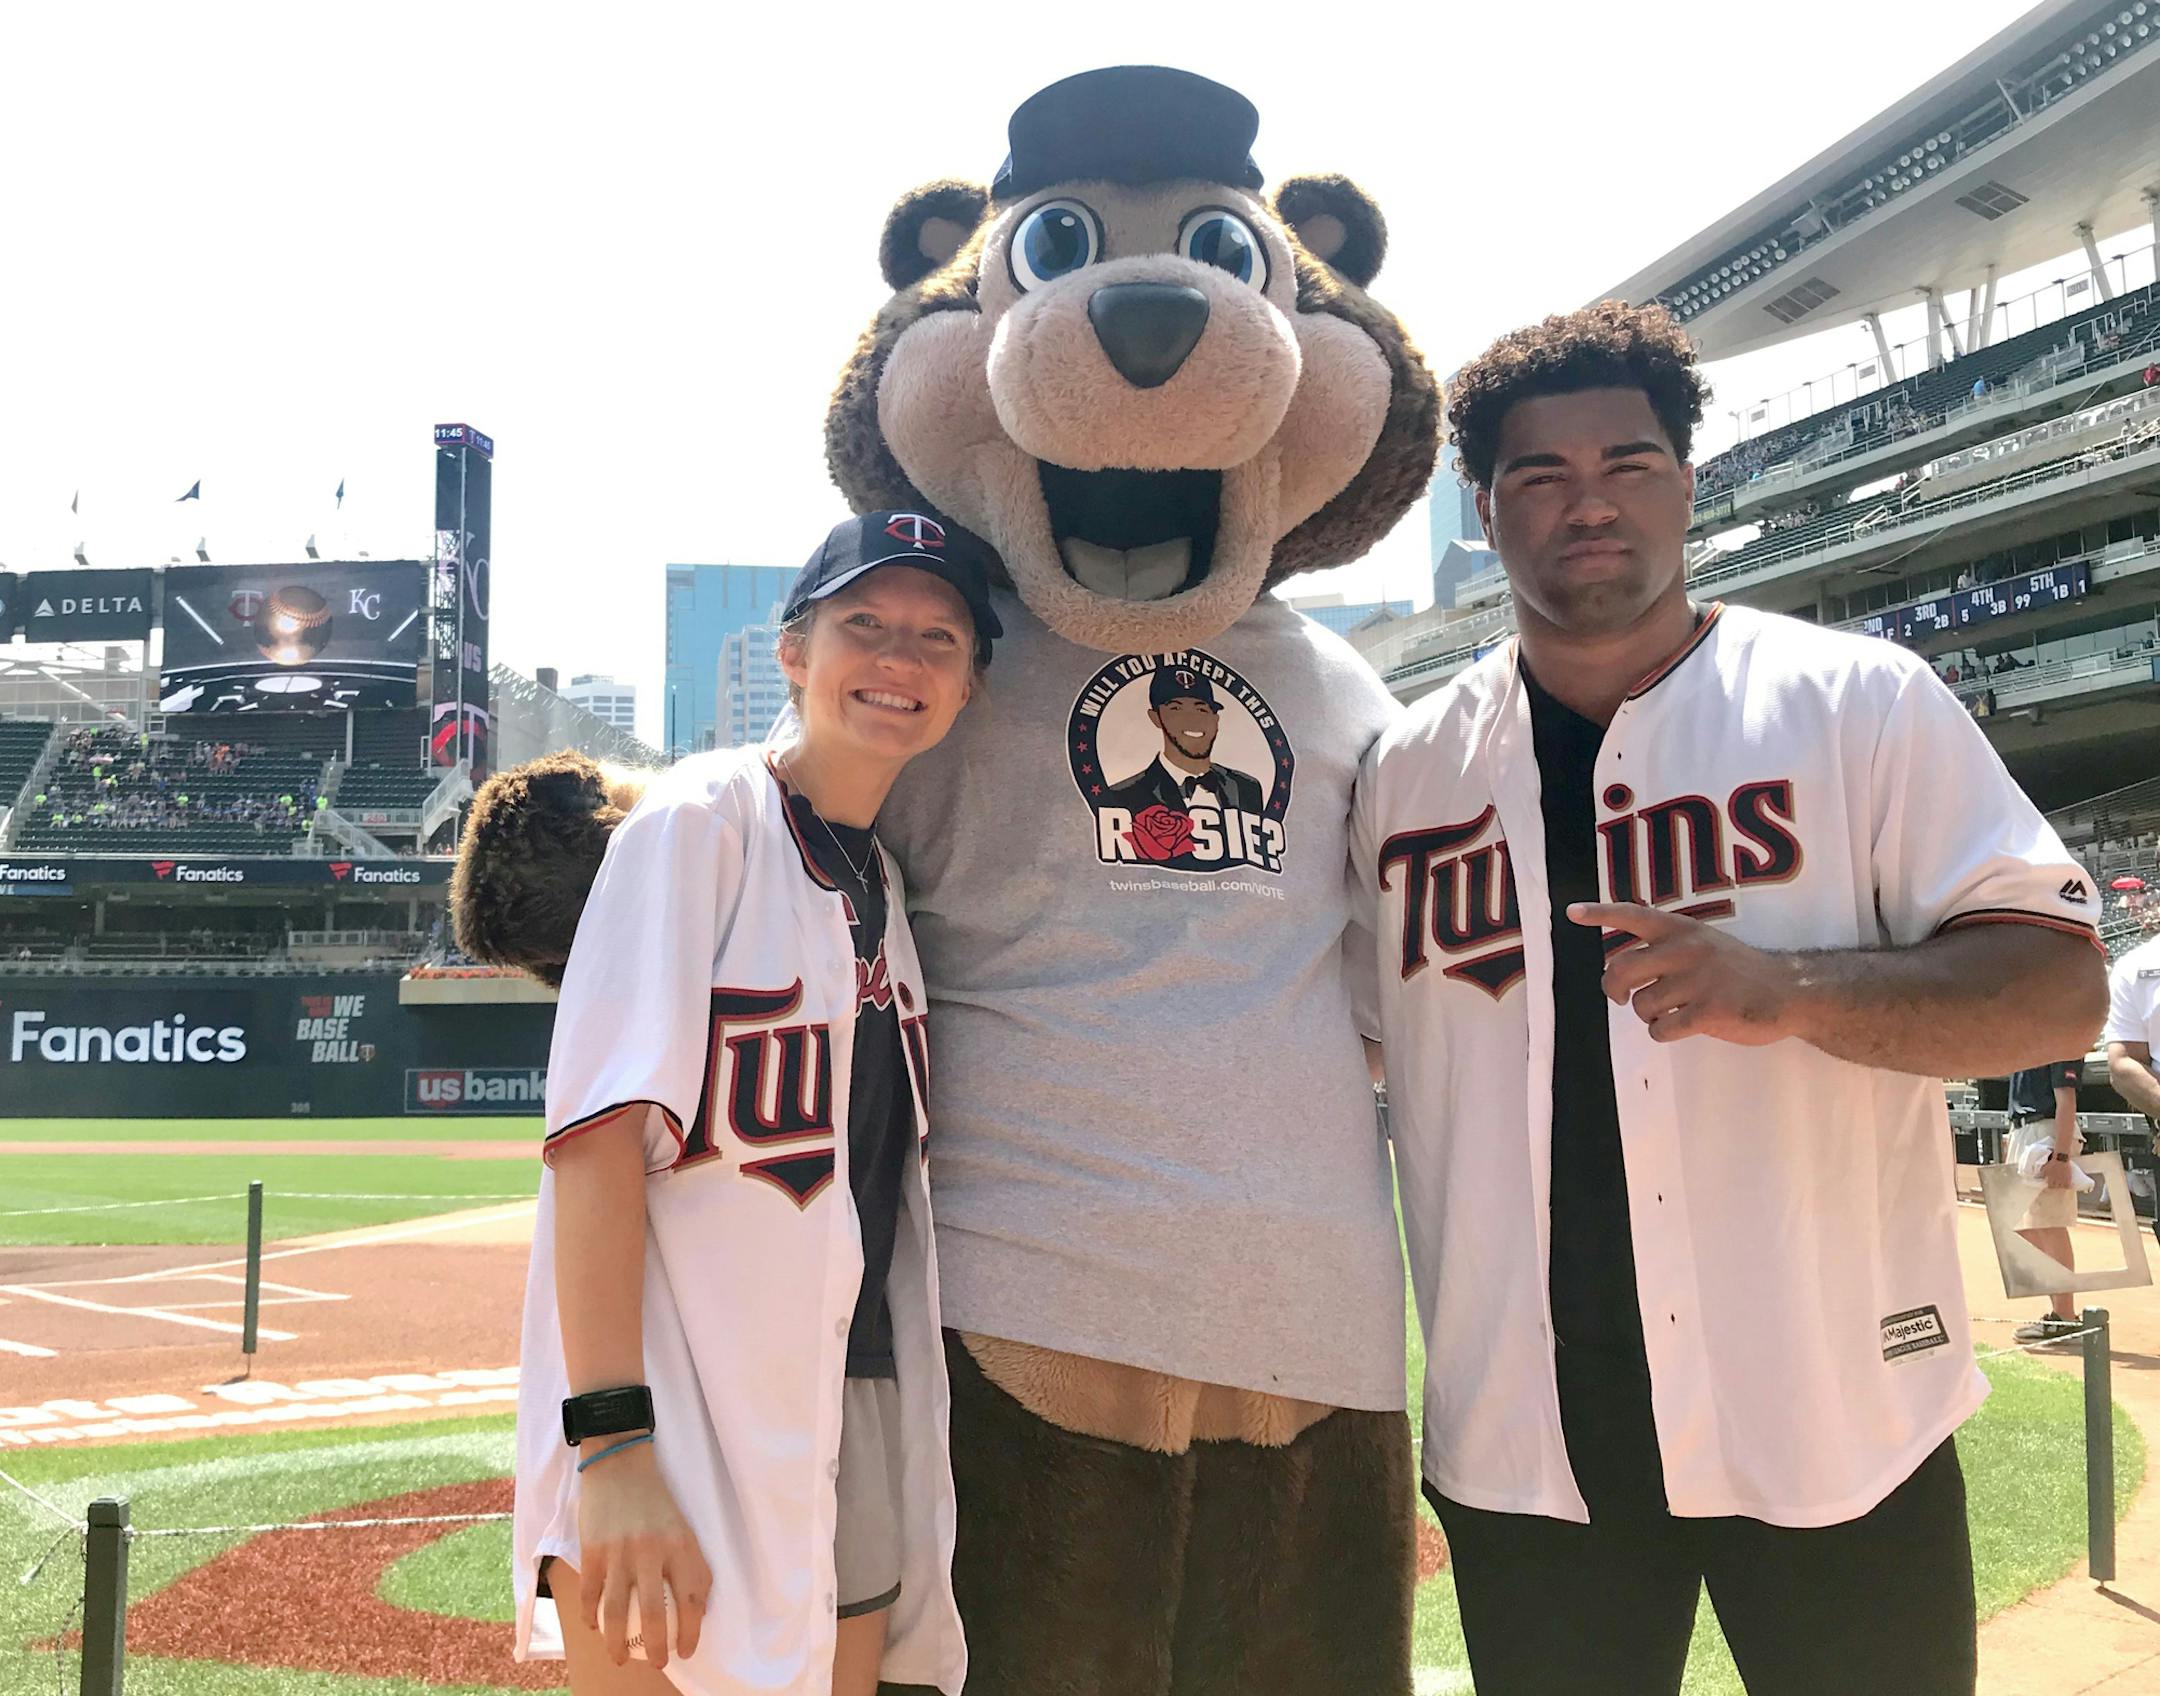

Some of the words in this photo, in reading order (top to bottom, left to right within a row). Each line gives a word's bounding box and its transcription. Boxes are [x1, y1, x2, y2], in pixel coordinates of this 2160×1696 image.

[435, 428, 463, 438] 11:45
[2030, 572, 2055, 592] 5TH
[1971, 586, 1994, 607] 4TH
[2052, 584, 2069, 600] 1B
[61, 597, 143, 615] DELTA
[348, 588, 381, 620] KC
[1990, 600, 2007, 616] 3B
[2015, 594, 2031, 610] 99
[1915, 602, 1938, 622] 3RD
[1961, 609, 1970, 622] 5
[1904, 624, 1913, 637] 2
[1934, 614, 1949, 630] 2B
[1079, 676, 1120, 717] WILL
[1115, 654, 1157, 680] YOU
[1237, 685, 1275, 729] THIS
[0, 864, 66, 881] Fanatics
[176, 865, 244, 882] Fanatics
[354, 866, 421, 883] Fanatics
[333, 995, 365, 1017] WE
[11, 1010, 247, 1063] Fanatics
[296, 1018, 349, 1040] BASE
[312, 1040, 359, 1062] BALL
[1887, 1317, 1934, 1340] Majestic
